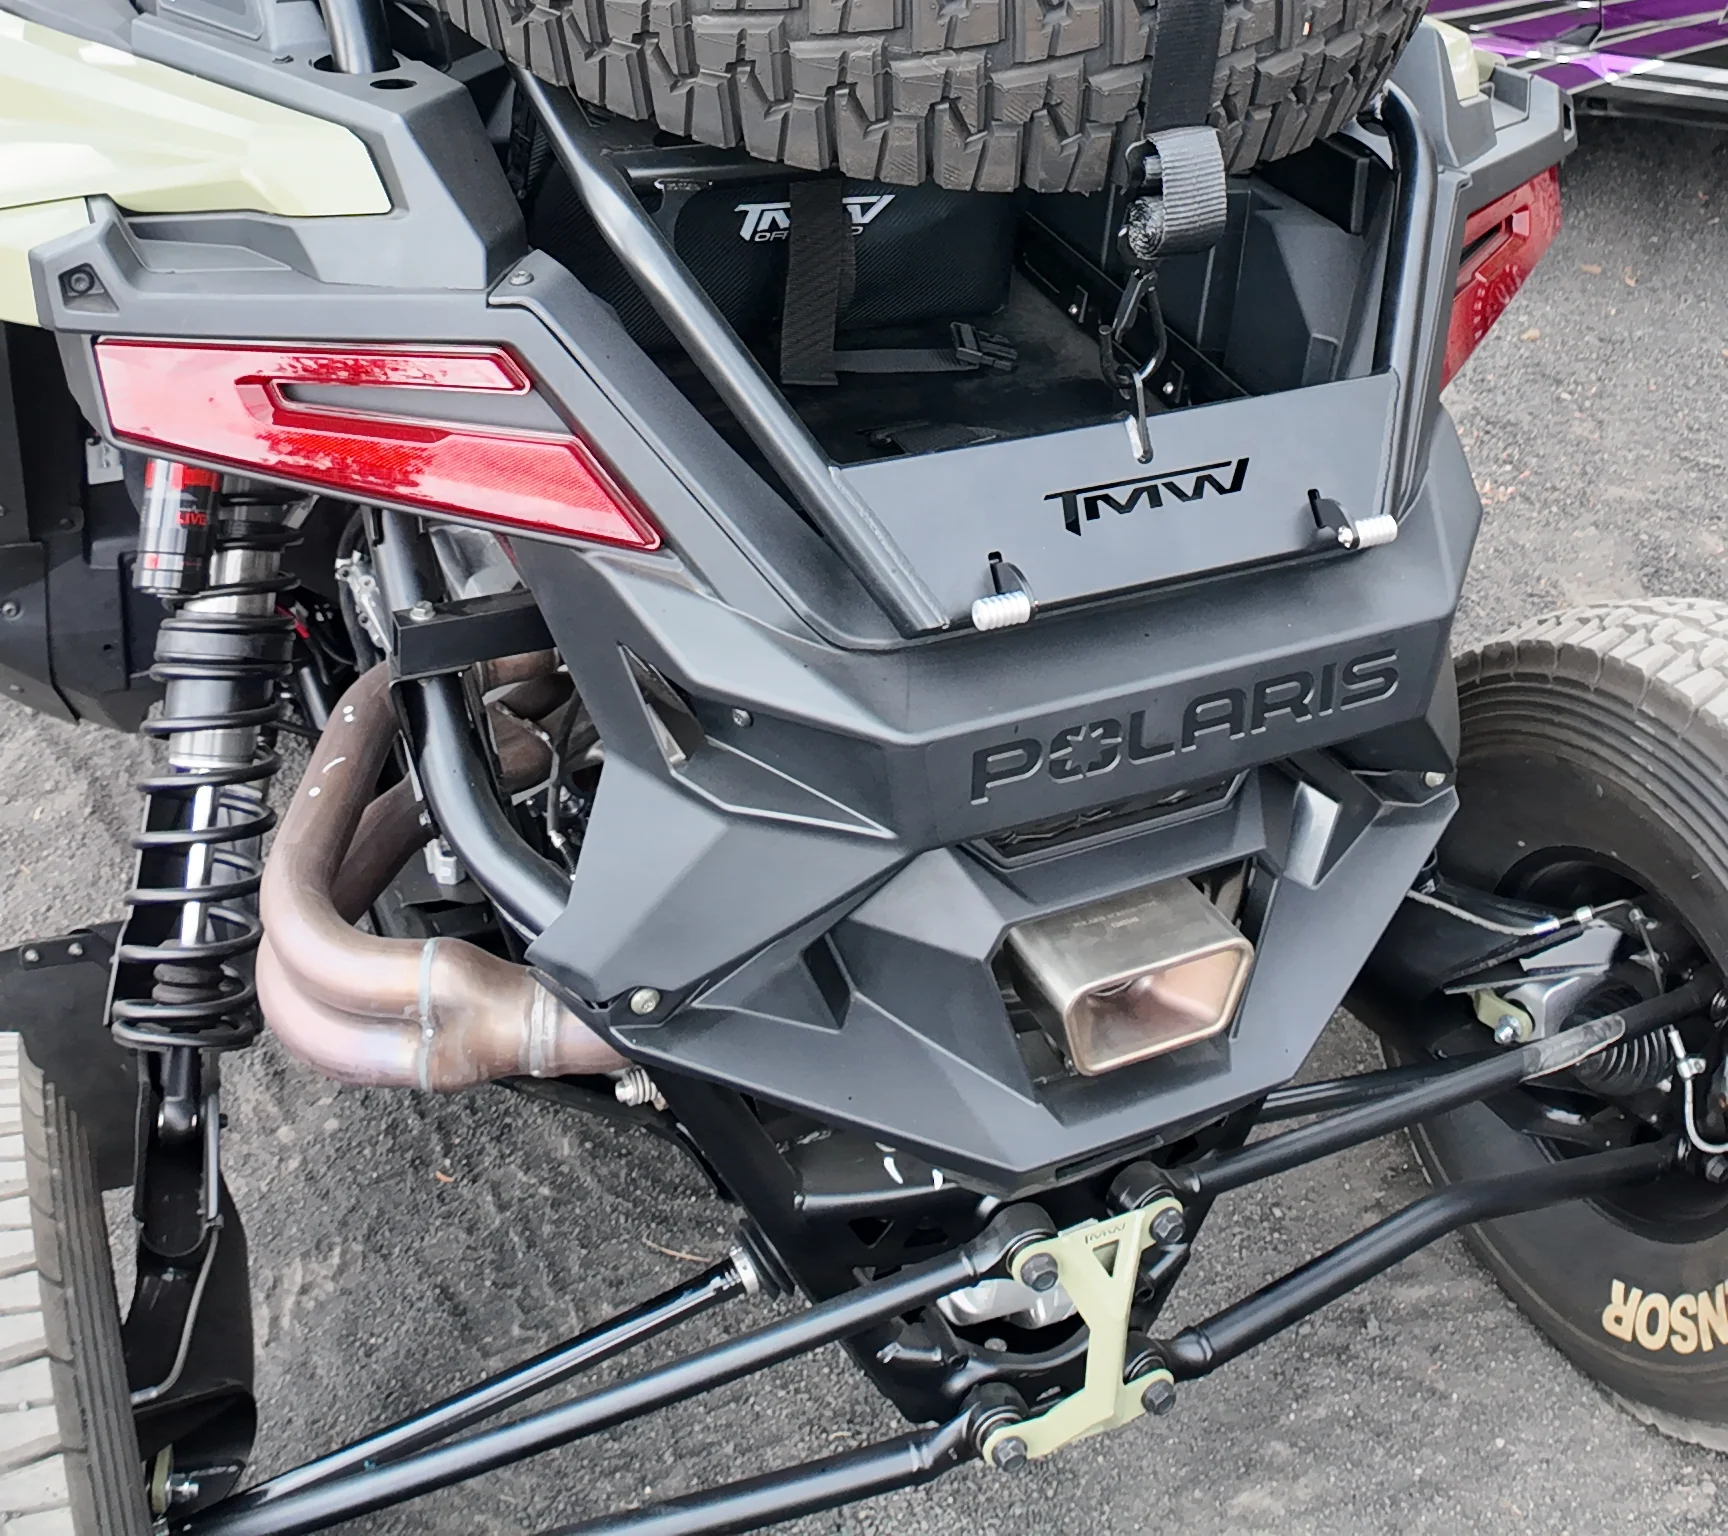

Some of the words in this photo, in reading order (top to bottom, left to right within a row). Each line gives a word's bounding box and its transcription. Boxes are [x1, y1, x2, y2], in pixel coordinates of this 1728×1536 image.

[1044, 457, 1250, 537] TMW
[970, 648, 1399, 805] POLARIS
[1601, 1278, 1728, 1354] NSOR
